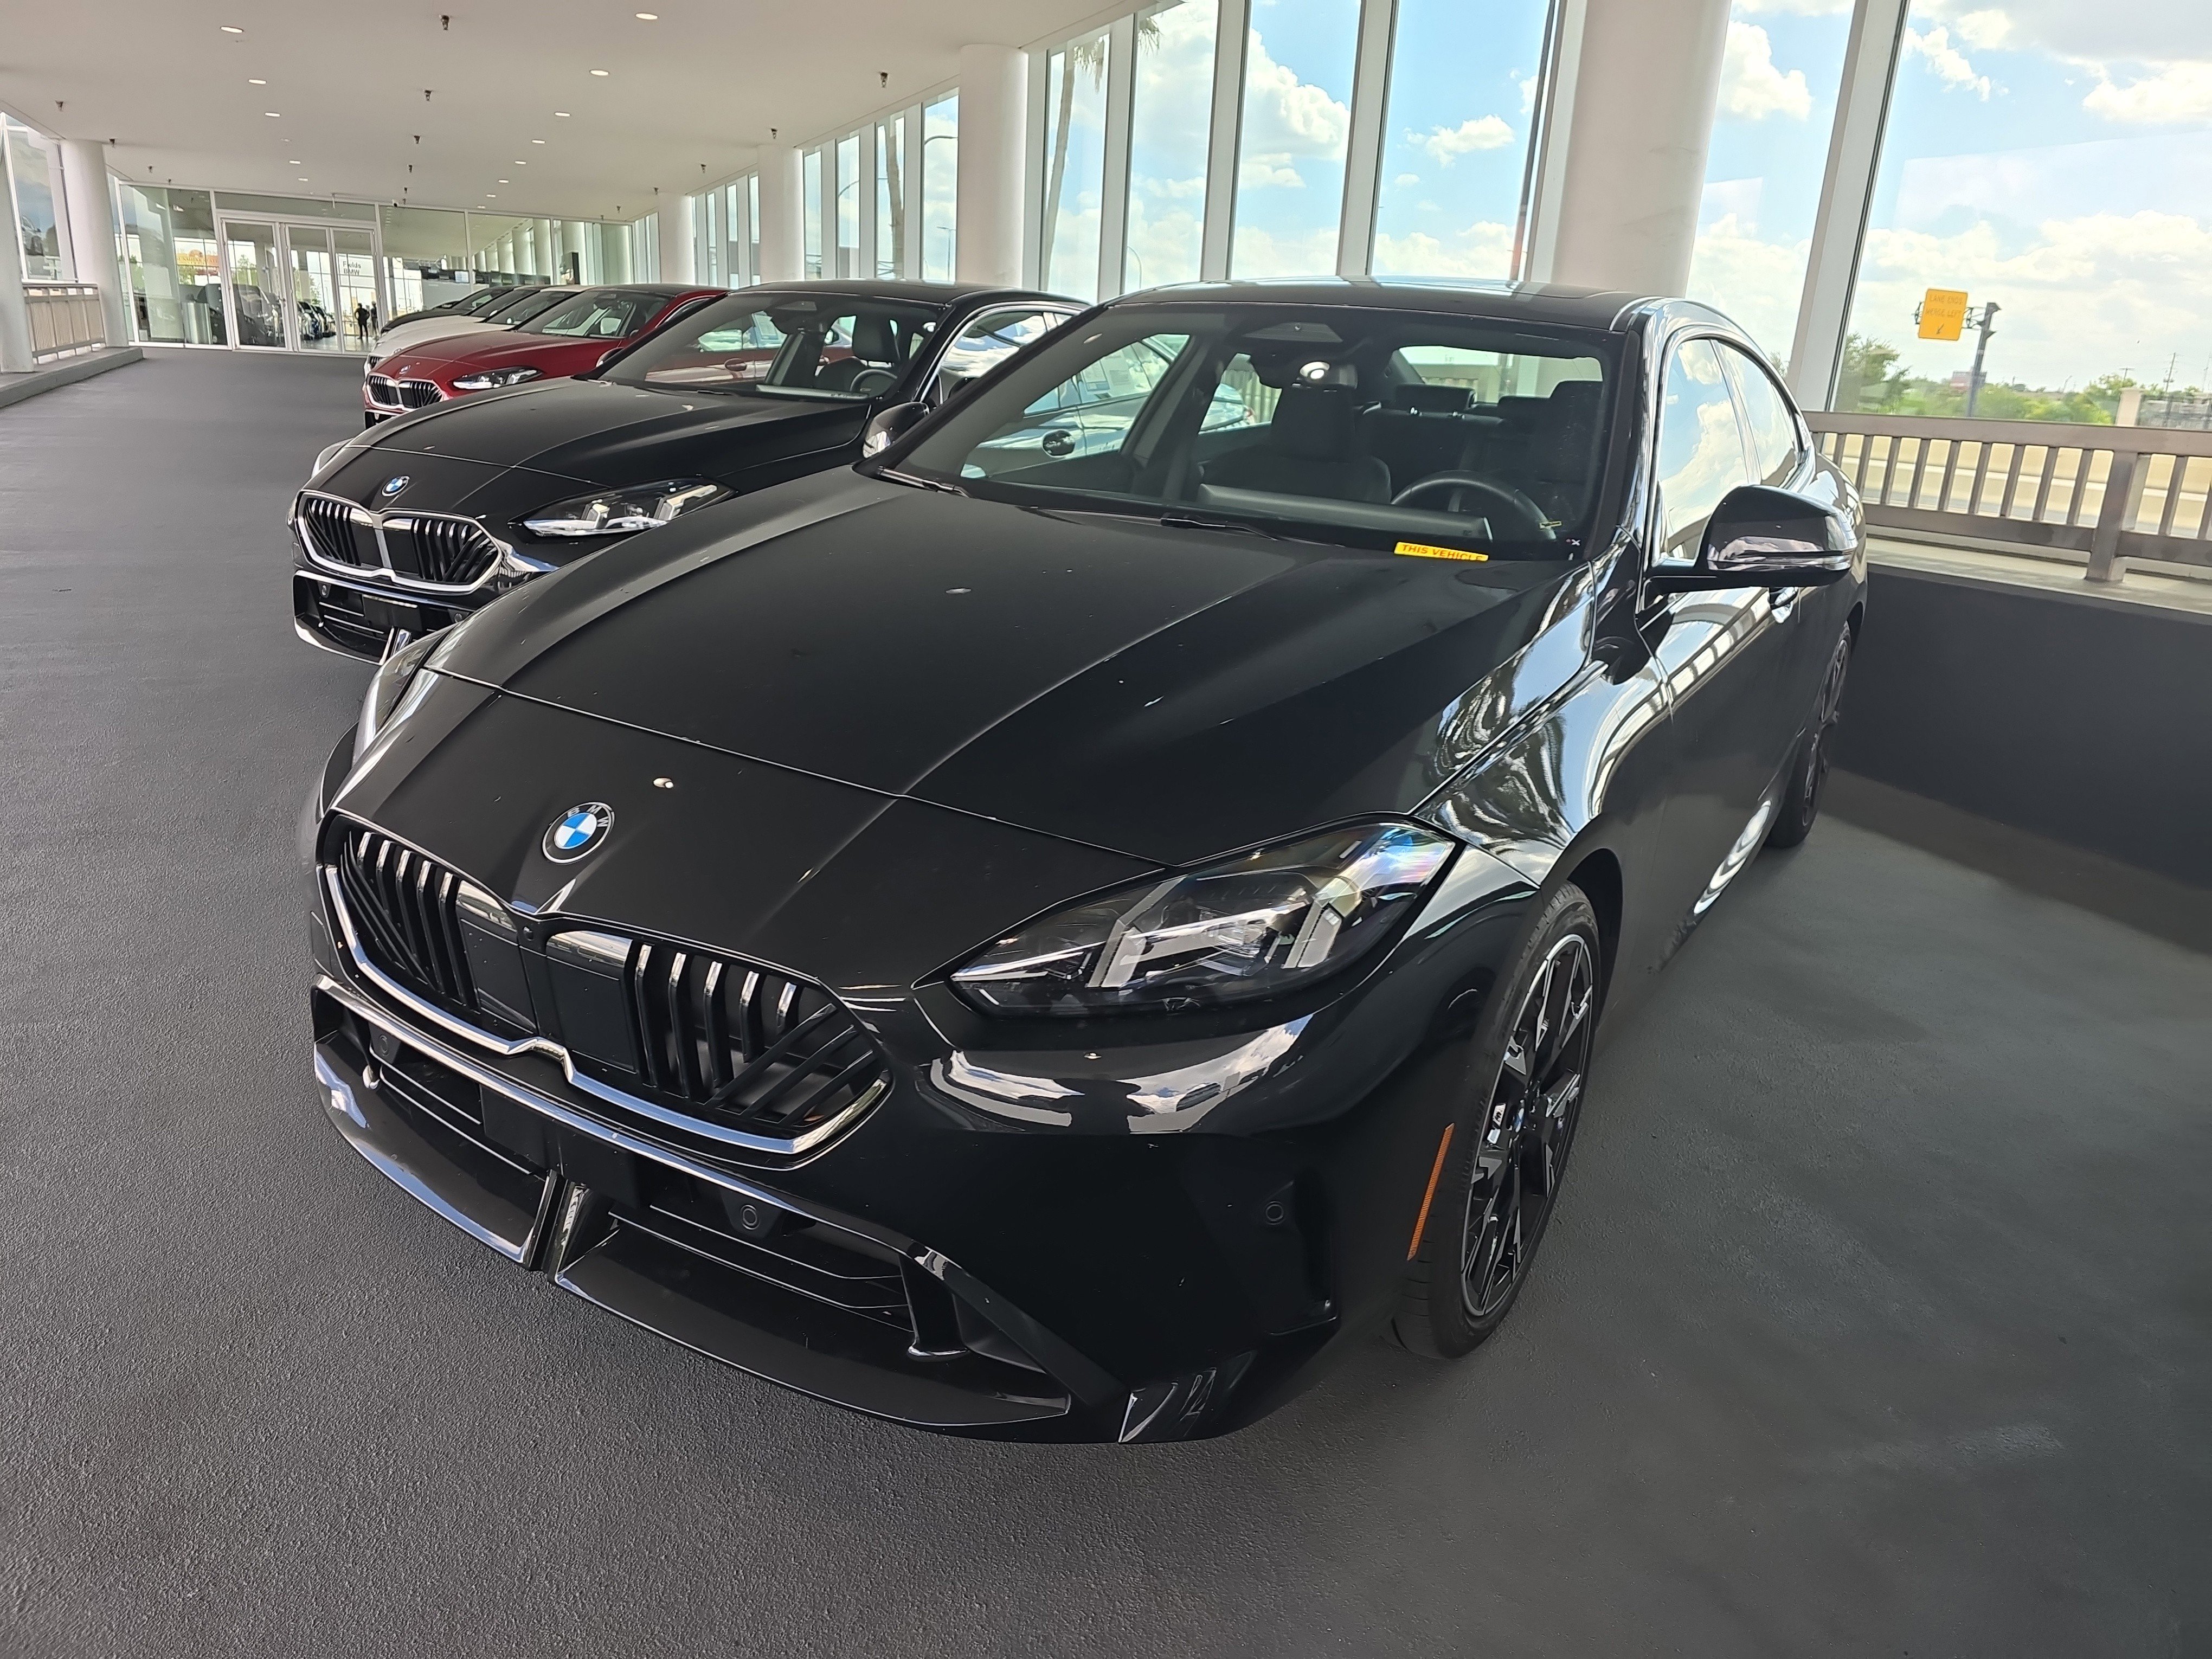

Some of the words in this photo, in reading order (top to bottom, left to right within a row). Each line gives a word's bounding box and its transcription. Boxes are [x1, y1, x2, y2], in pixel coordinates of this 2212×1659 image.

[1947, 310, 1962, 318] LEFT
[1402, 544, 1427, 554] THIS
[567, 805, 609, 827] BMW
